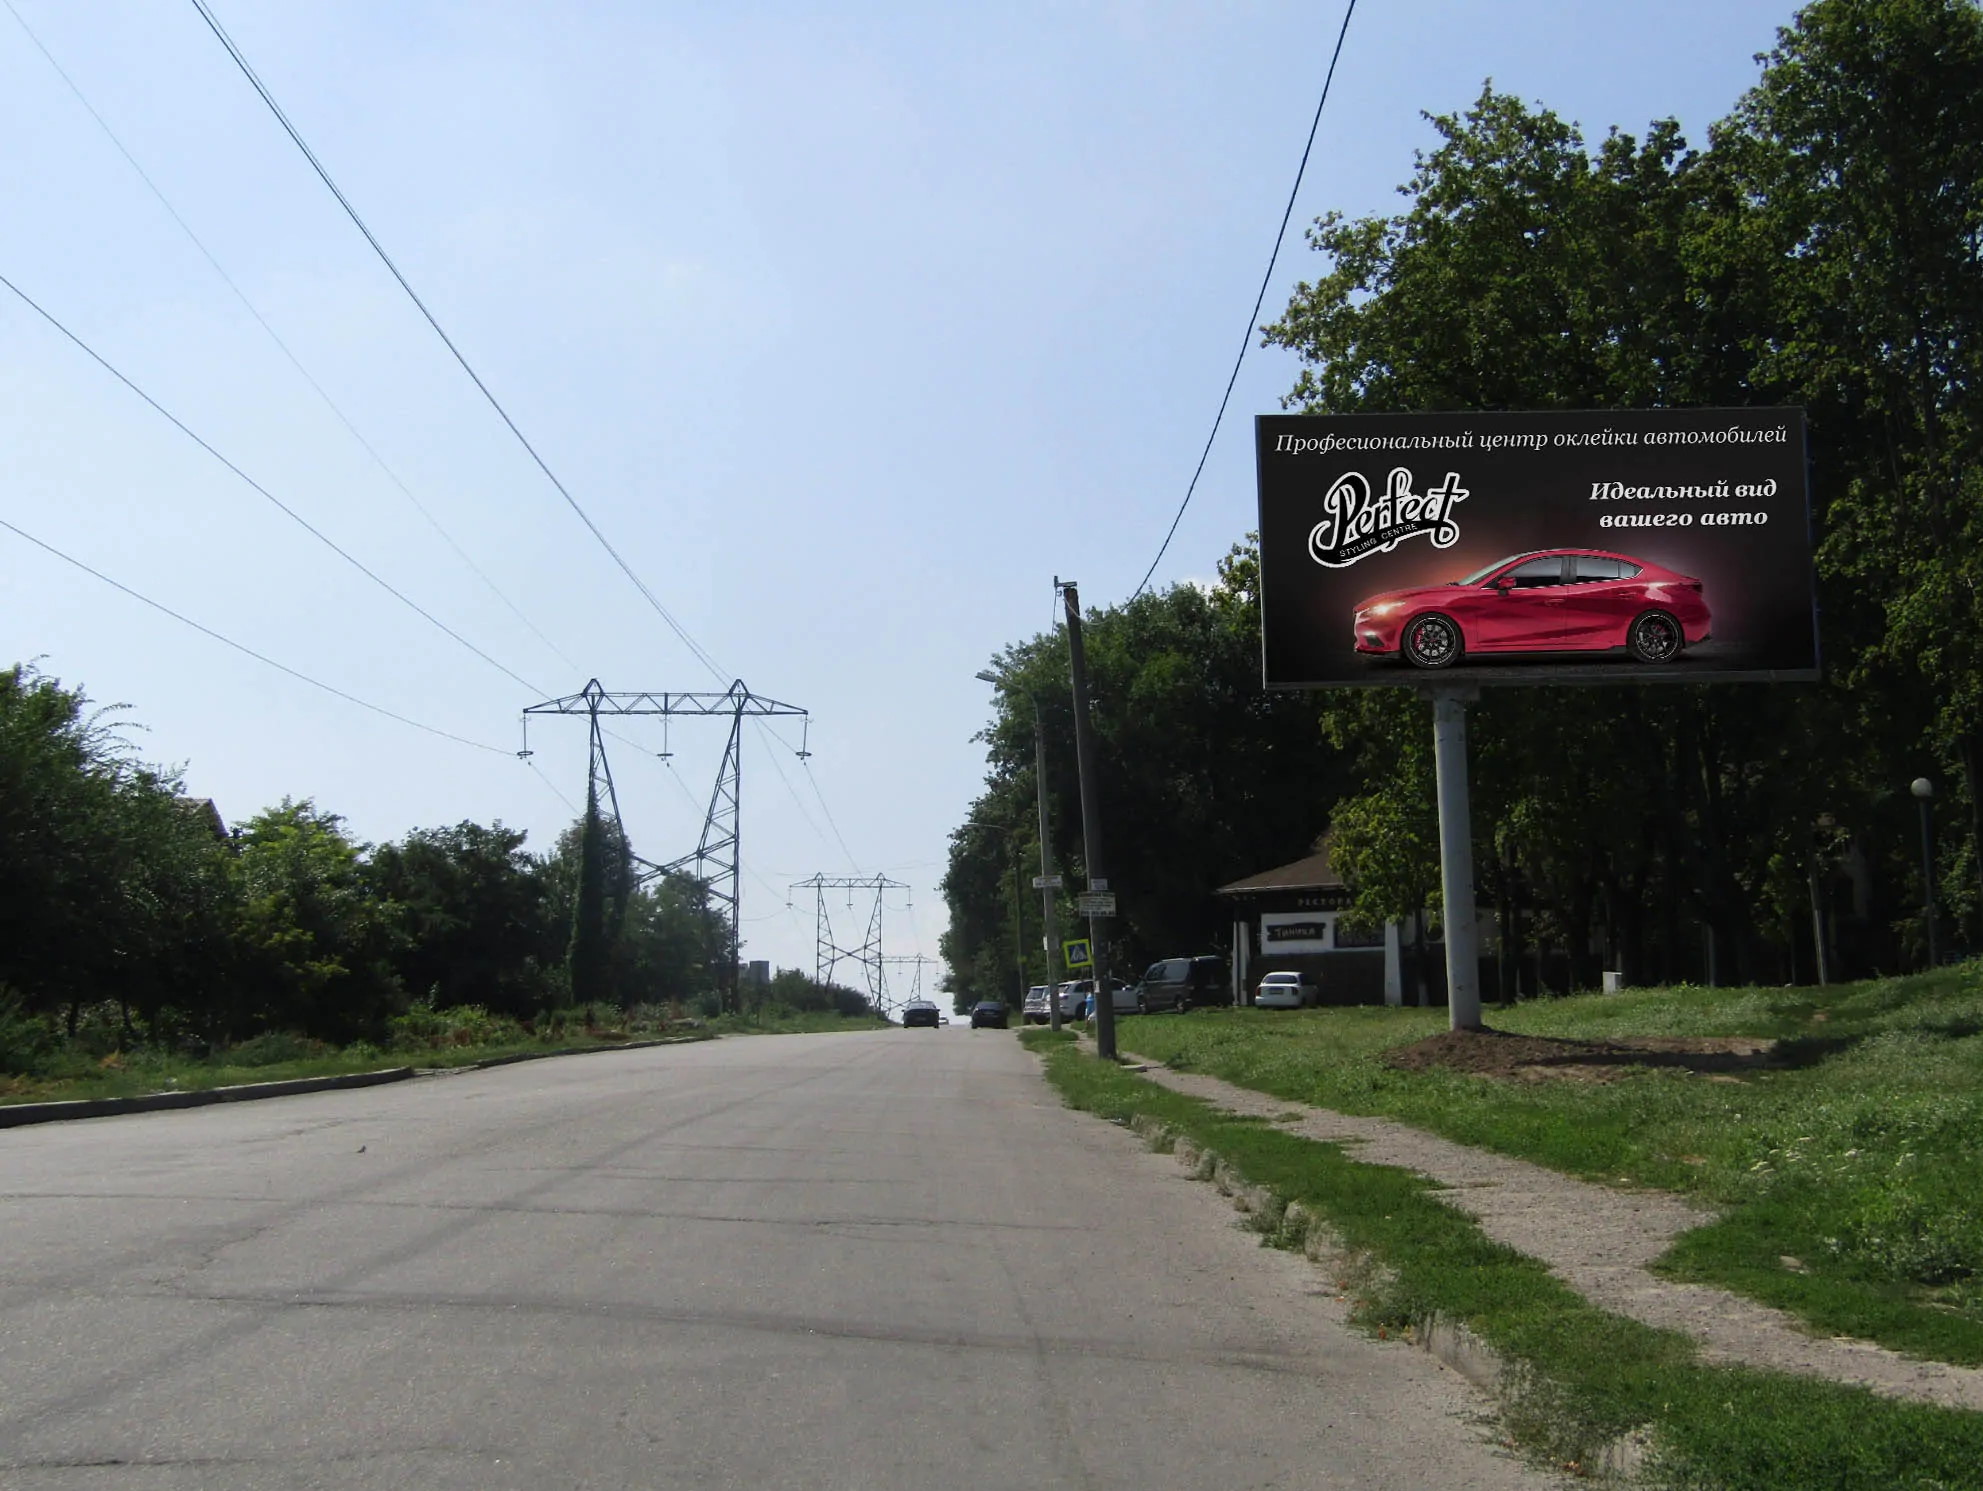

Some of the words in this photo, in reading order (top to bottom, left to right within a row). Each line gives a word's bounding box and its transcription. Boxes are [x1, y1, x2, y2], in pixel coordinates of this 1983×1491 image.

[1275, 431, 1474, 455] Професиональный
[1479, 433, 1548, 451] центр
[1553, 428, 1638, 446] оклейки
[1643, 425, 1787, 445] автомобилей
[1589, 480, 1730, 500] Идеальный
[1735, 479, 1778, 498] вид
[1308, 467, 1470, 568] Perfect
[1599, 513, 1693, 528] вашего
[1700, 511, 1768, 526] авто
[1339, 537, 1377, 557] STYLING
[1380, 523, 1418, 540] CENTRE
